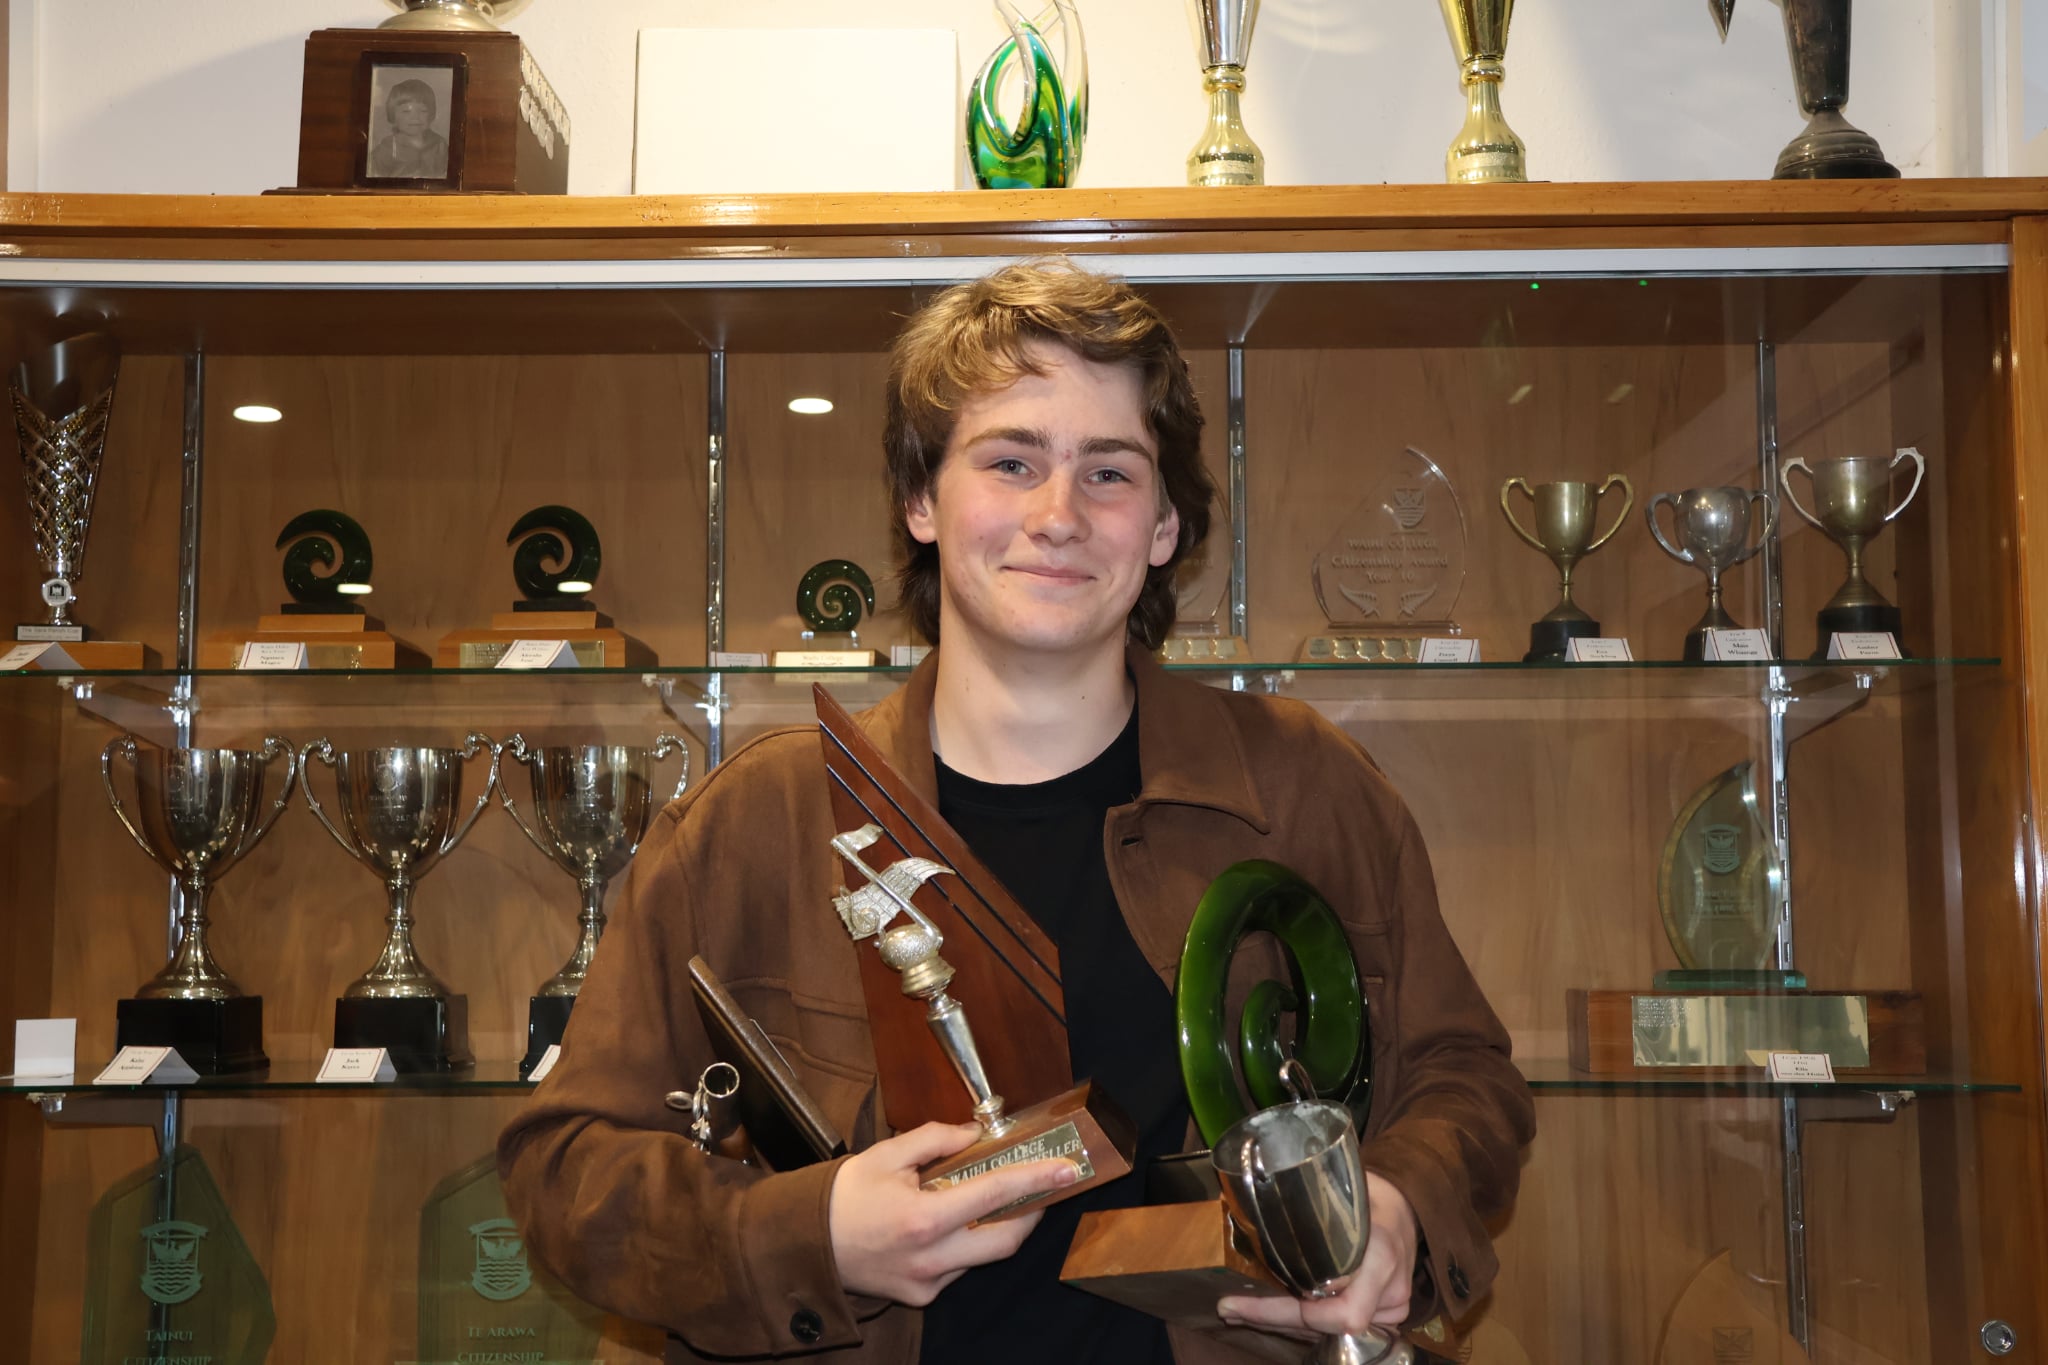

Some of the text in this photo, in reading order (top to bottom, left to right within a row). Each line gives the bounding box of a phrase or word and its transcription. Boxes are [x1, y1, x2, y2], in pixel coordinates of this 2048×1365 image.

[950, 1138, 1046, 1186] WAIHI COLLEGE
[143, 1328, 193, 1342] TAINUI
[487, 1326, 536, 1338] ARAWA
[457, 1350, 545, 1363] CITIZENSHIP
